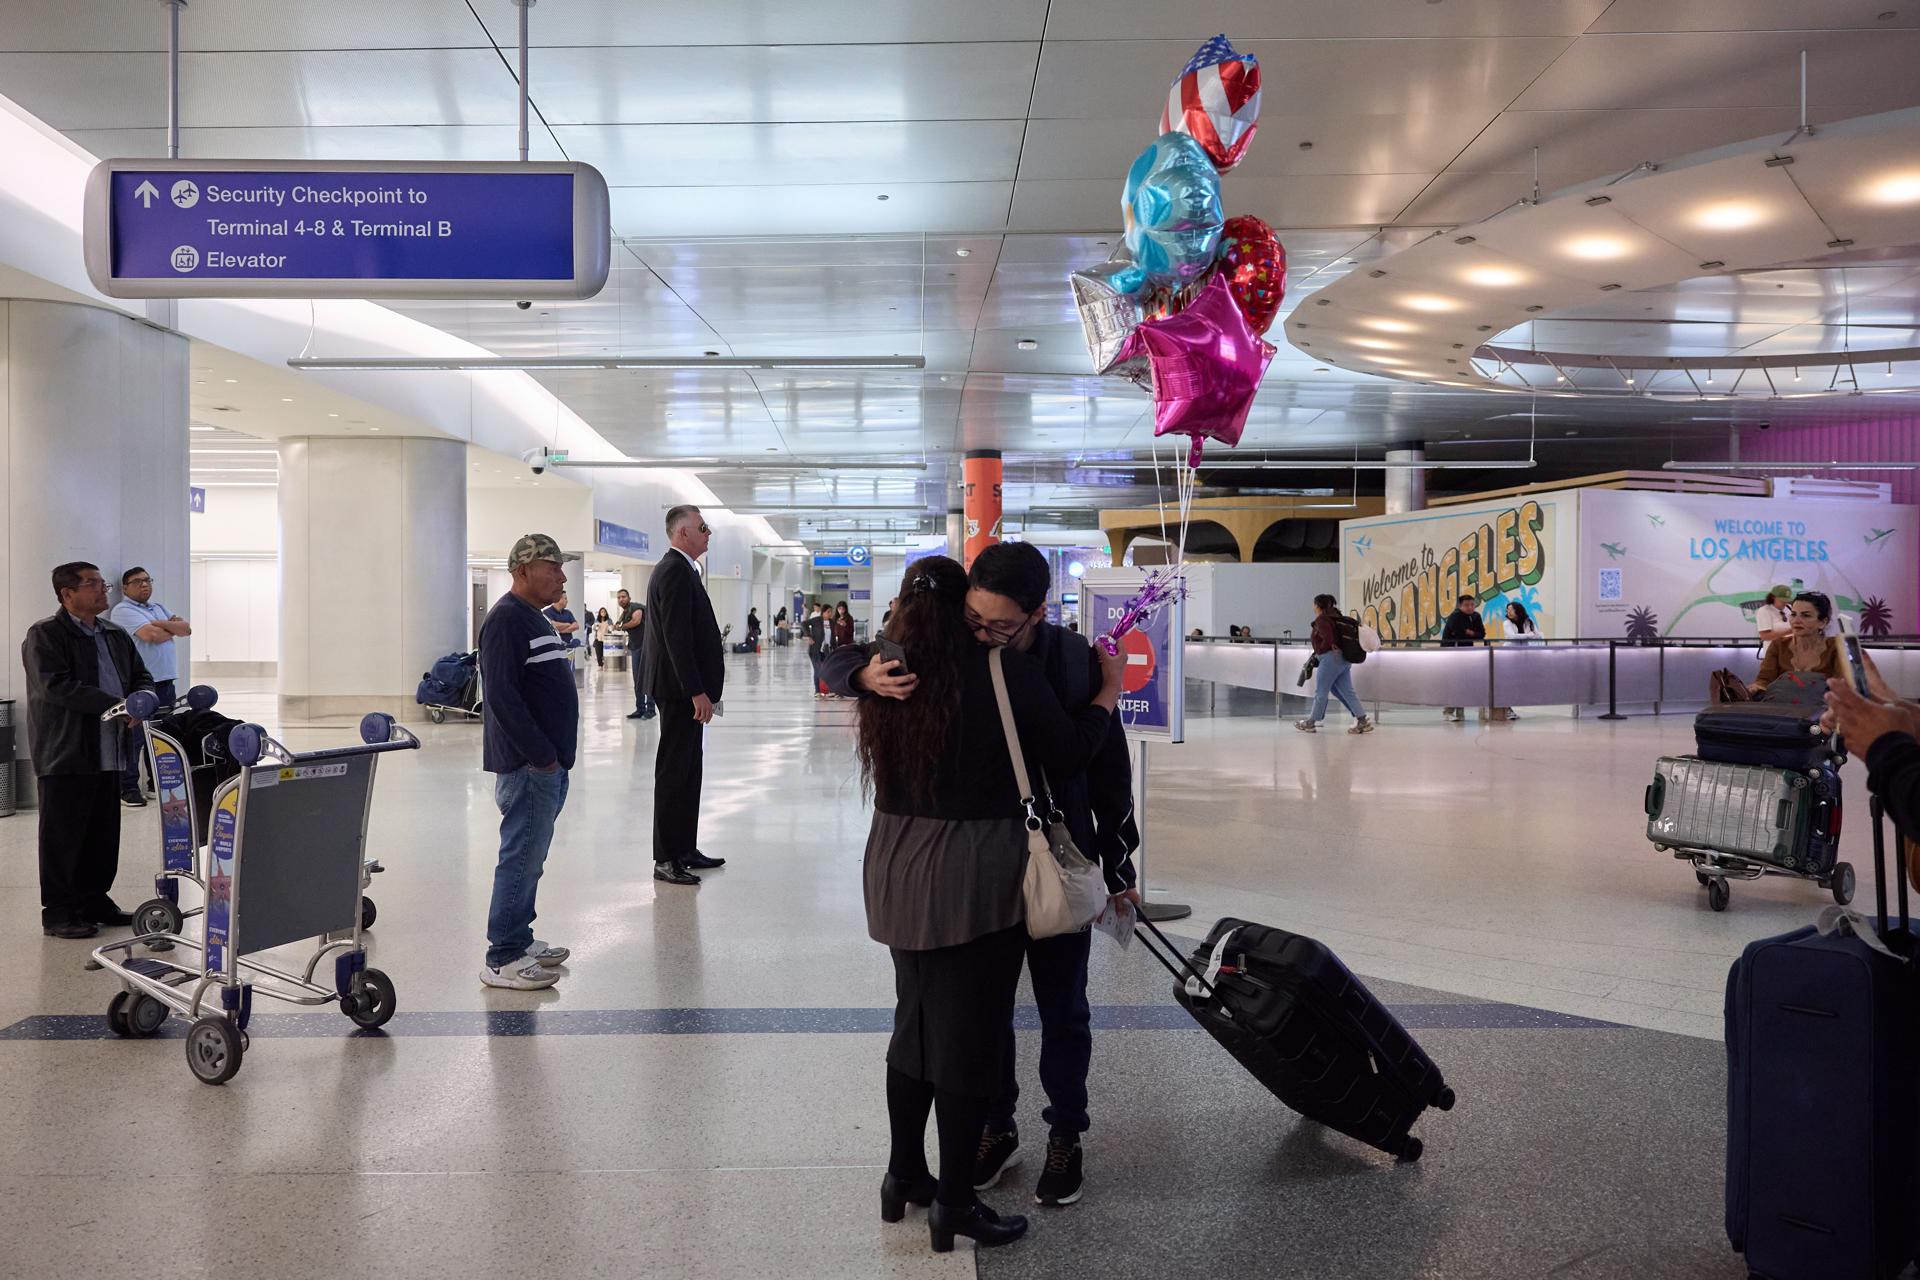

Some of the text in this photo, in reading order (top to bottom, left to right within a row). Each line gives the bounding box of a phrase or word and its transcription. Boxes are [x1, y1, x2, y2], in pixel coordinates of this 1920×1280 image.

[206, 185, 428, 208] Security Checkpoint to
[206, 218, 452, 237] Terminal 4-8 & Terminal B
[206, 251, 287, 268] Elevator
[1714, 519, 1806, 536] WELCOME TO
[1690, 537, 1830, 562] LOS ANGELES
[1362, 543, 1434, 606] Welcome to
[1399, 500, 1545, 647] ANGELES
[1107, 607, 1125, 620] DO
[1117, 699, 1150, 713] NTER
